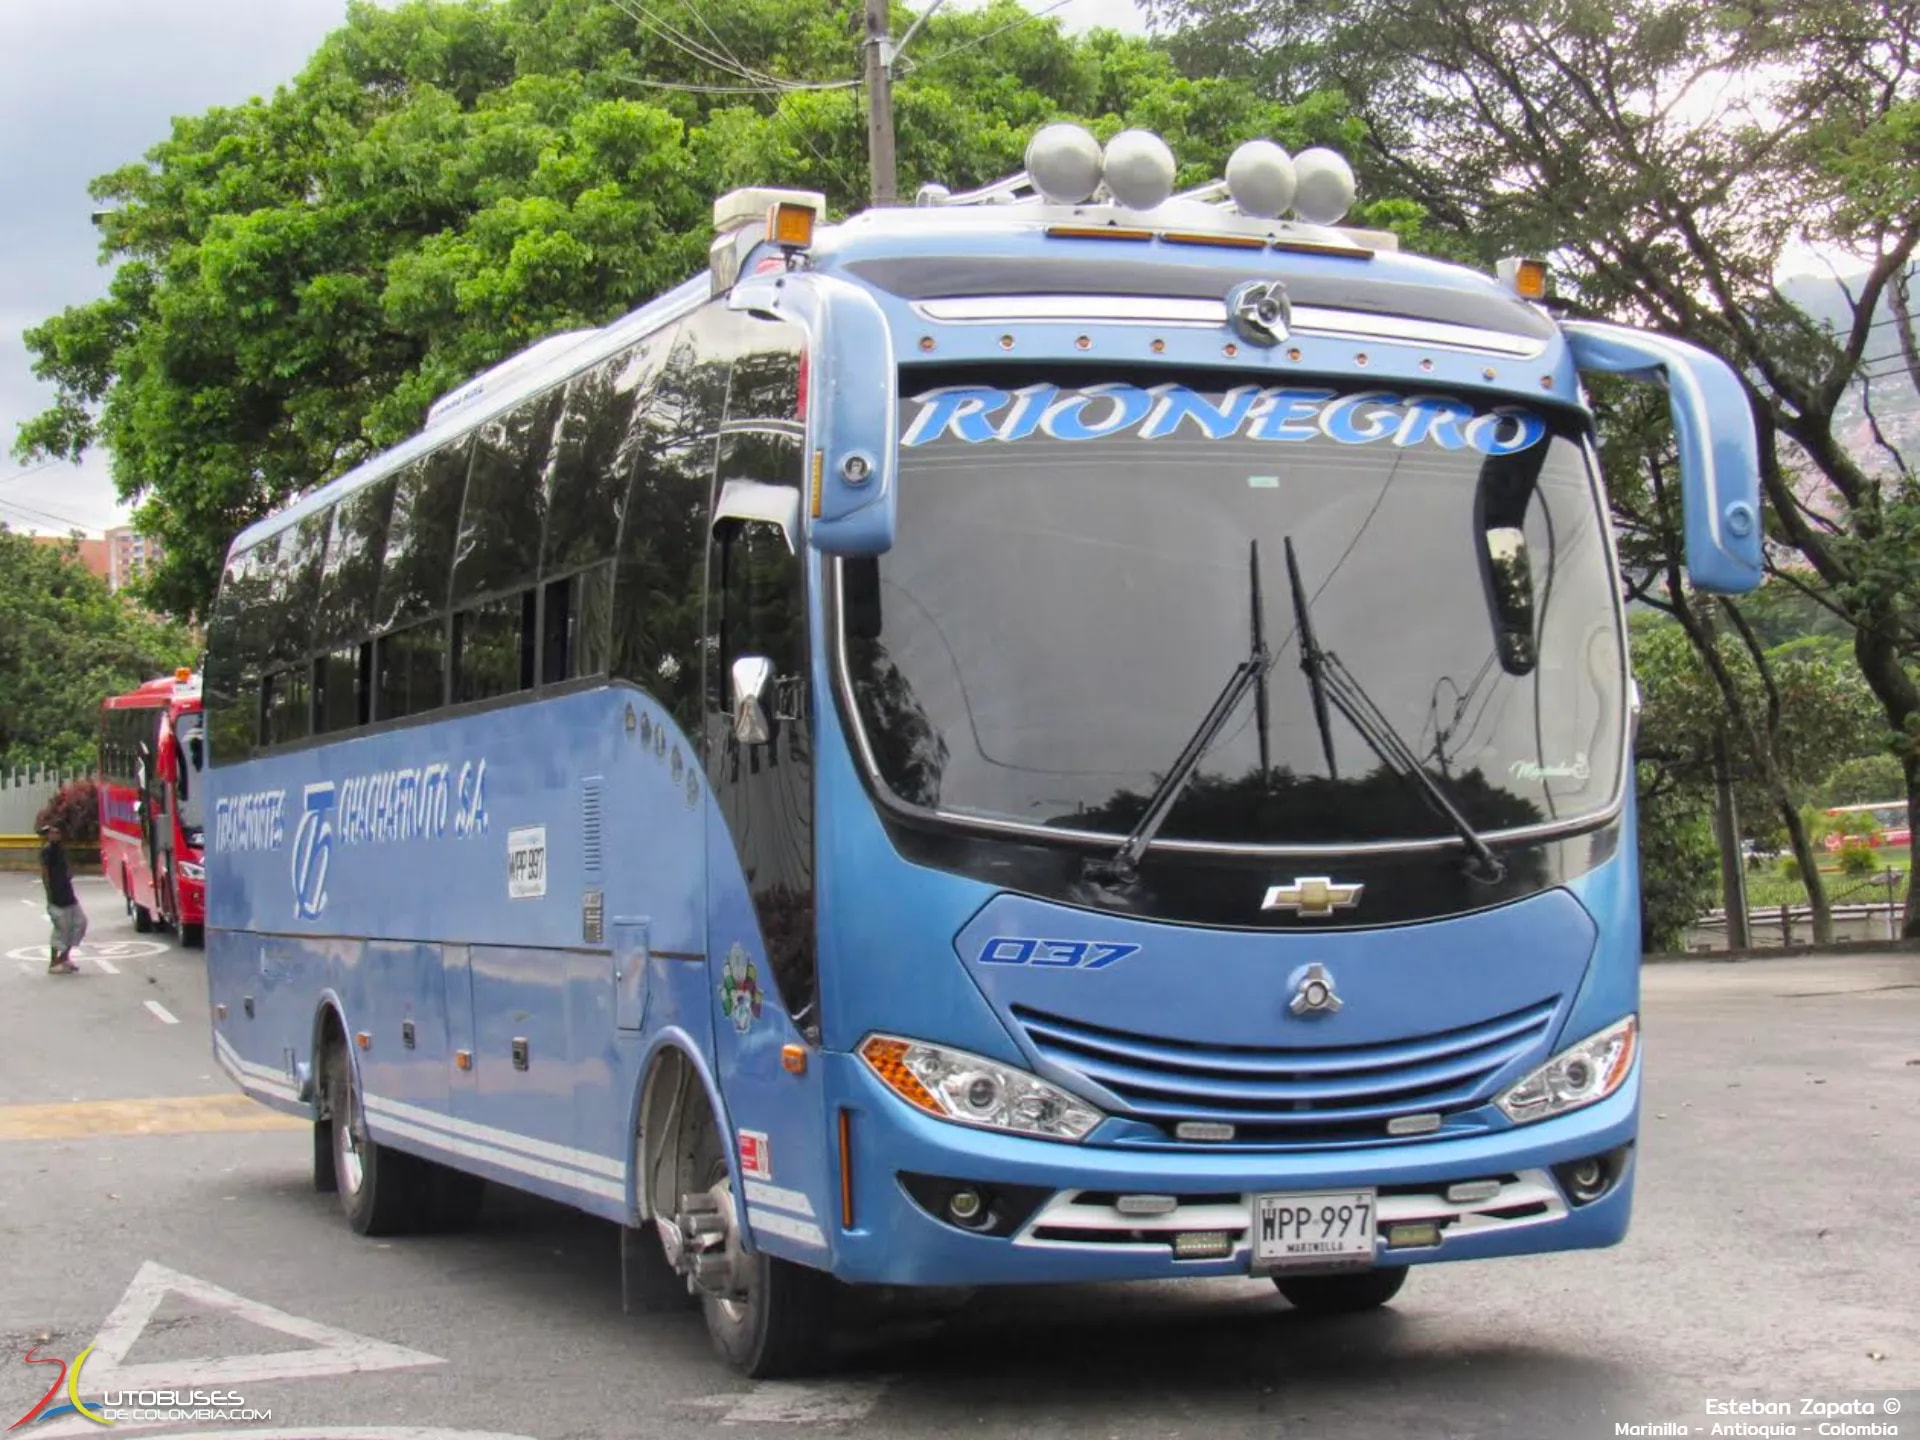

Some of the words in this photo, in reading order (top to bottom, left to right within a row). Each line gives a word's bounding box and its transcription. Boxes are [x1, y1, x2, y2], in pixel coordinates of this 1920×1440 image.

[900, 382, 1547, 455] RIONEGRO
[978, 936, 1143, 969] 037
[1261, 1206, 1312, 1241] WPP
[1320, 1203, 1370, 1239] 997
[1286, 1241, 1344, 1252] MARINILLA
